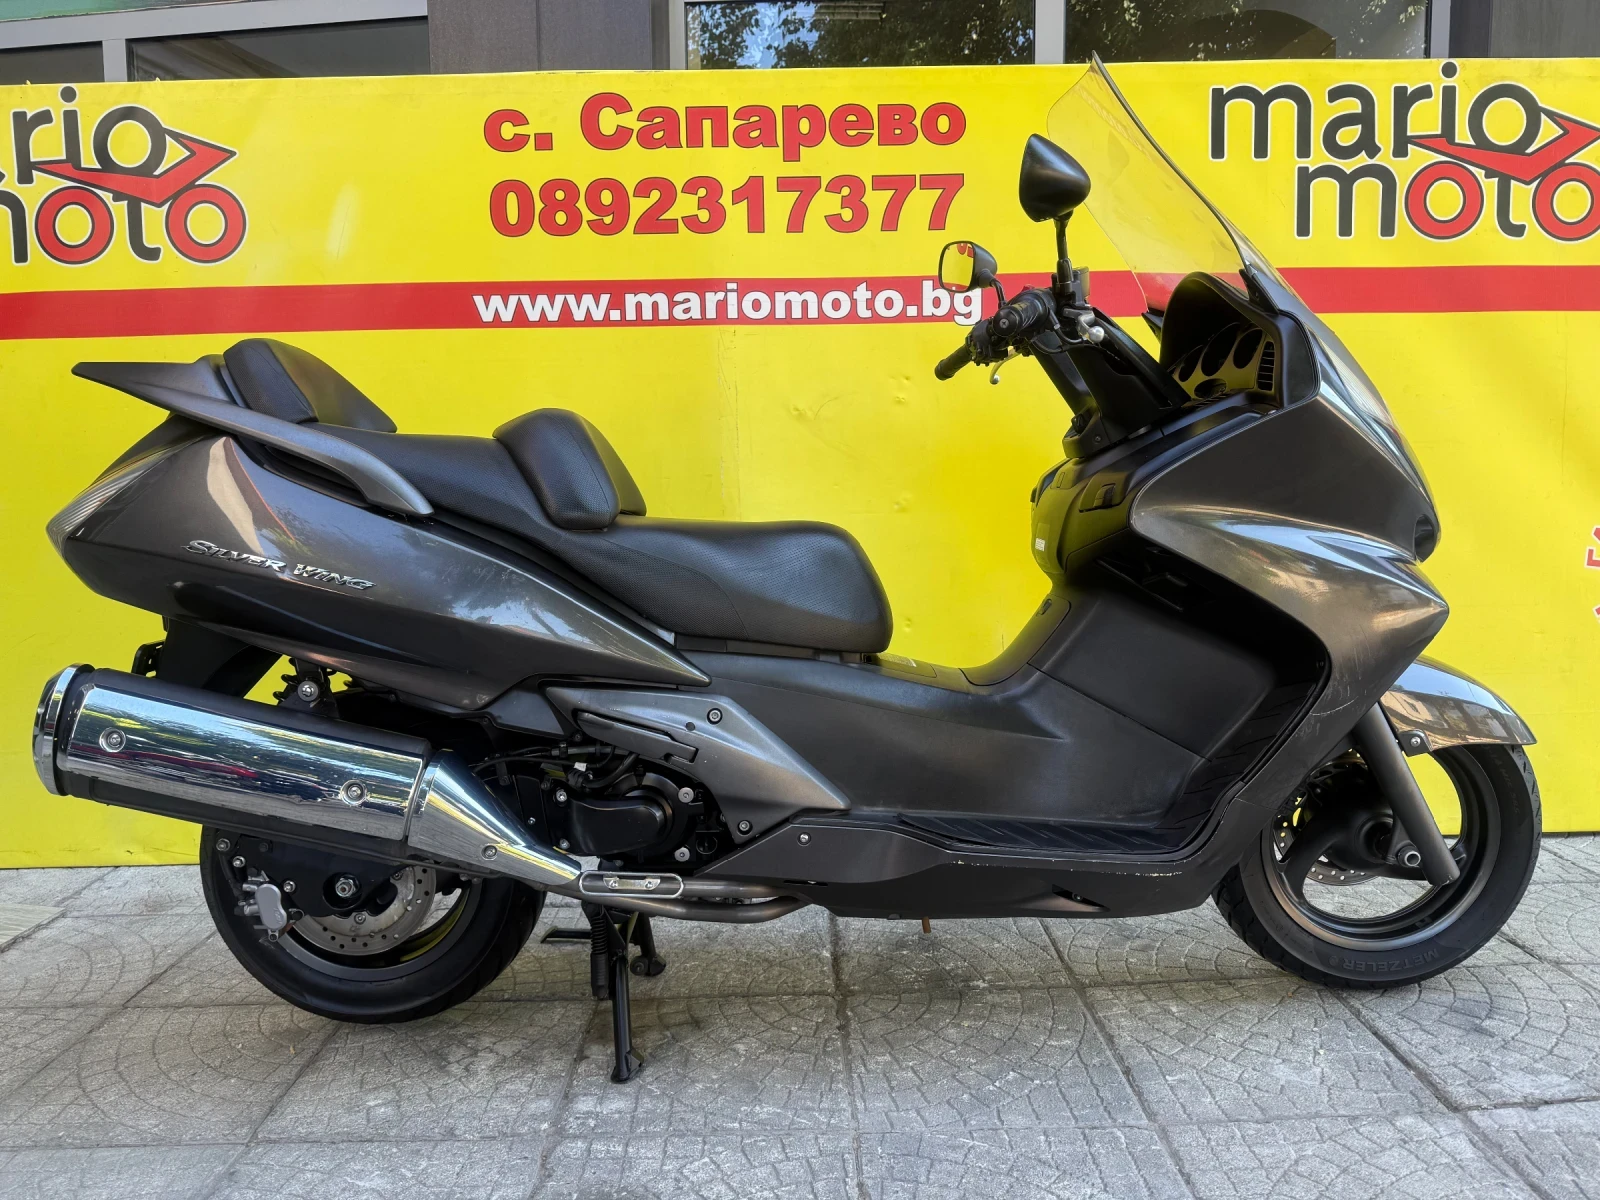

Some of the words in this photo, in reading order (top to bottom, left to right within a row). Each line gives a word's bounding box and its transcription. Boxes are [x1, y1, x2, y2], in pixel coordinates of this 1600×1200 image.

[0, 85, 168, 185] rio
[483, 108, 553, 152] с.
[580, 92, 967, 162] Сапарево
[1211, 61, 1542, 160] mario
[0, 186, 247, 265] oto
[489, 173, 965, 237] 0892317377
[1296, 161, 1600, 240] moto
[471, 281, 983, 326] www.mariomoto.bg
[293, 563, 376, 590] WING
[1343, 949, 1440, 972] METZELER
